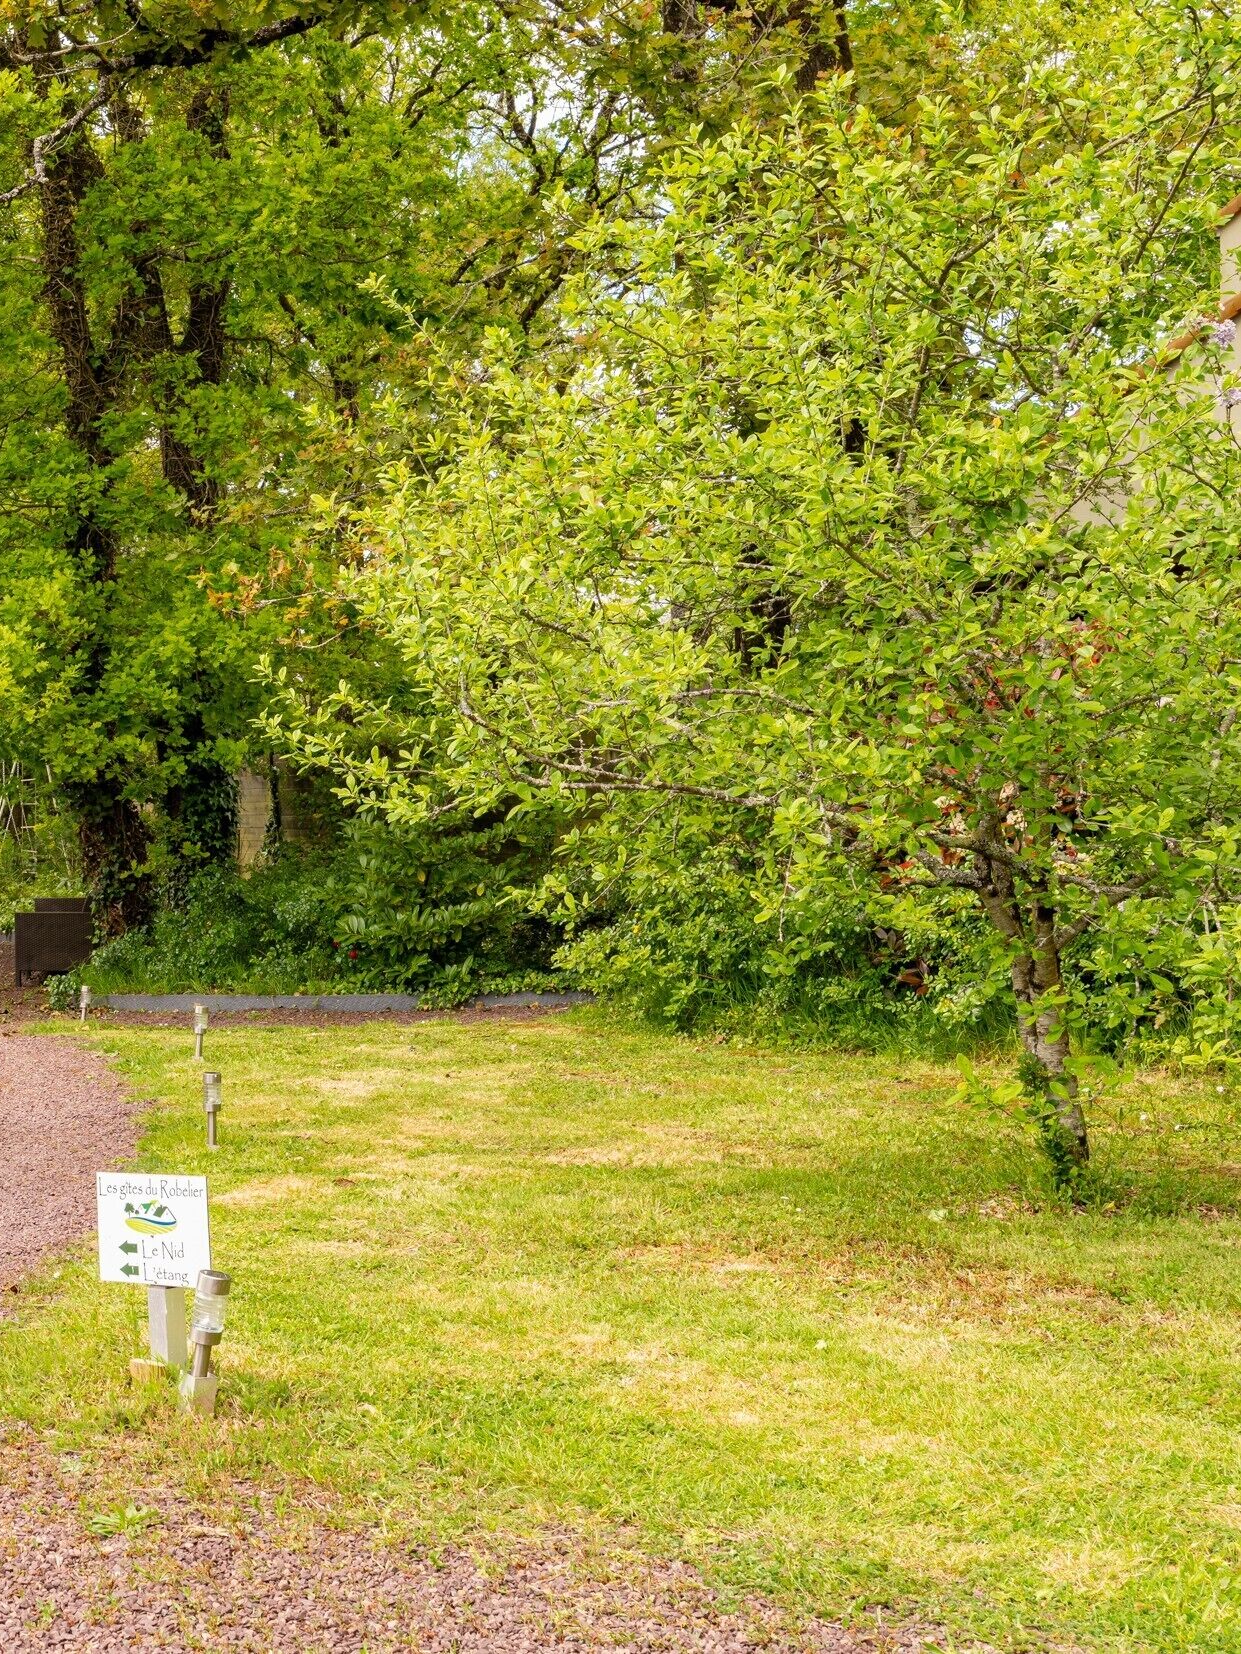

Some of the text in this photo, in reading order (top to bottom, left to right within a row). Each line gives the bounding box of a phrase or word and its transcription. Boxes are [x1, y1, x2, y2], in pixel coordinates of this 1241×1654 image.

[99, 1177, 204, 1200] Les gîtes du Robelier
[142, 1240, 185, 1260] Le Nid
[143, 1262, 190, 1286] L'étang
